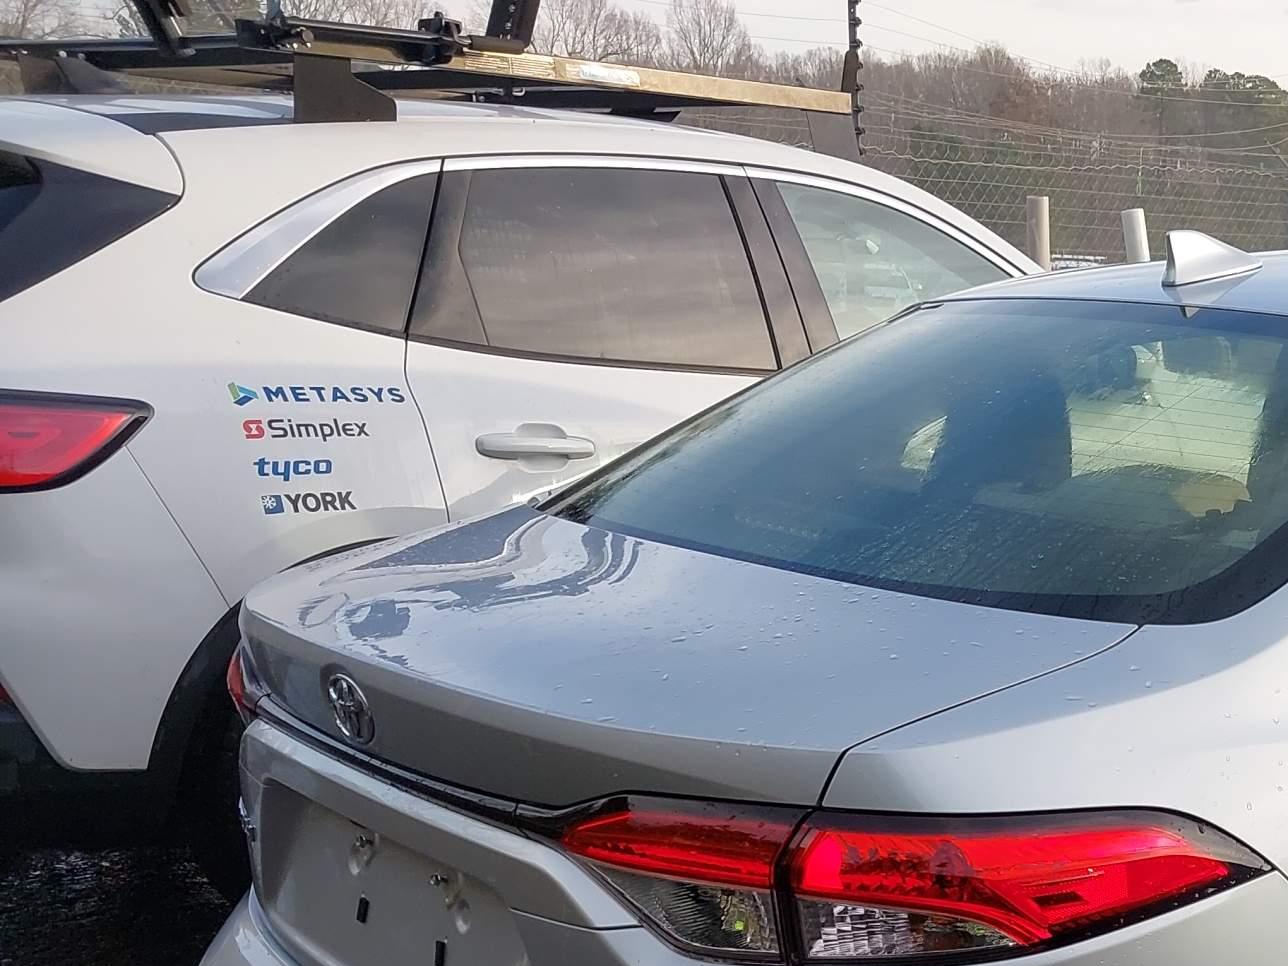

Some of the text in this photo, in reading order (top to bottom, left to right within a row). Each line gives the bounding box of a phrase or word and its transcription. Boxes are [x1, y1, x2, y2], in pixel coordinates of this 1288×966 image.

[262, 385, 406, 404] METASYS
[267, 418, 370, 442] Simplex
[253, 457, 333, 482] tyco
[284, 490, 357, 514] YORK
